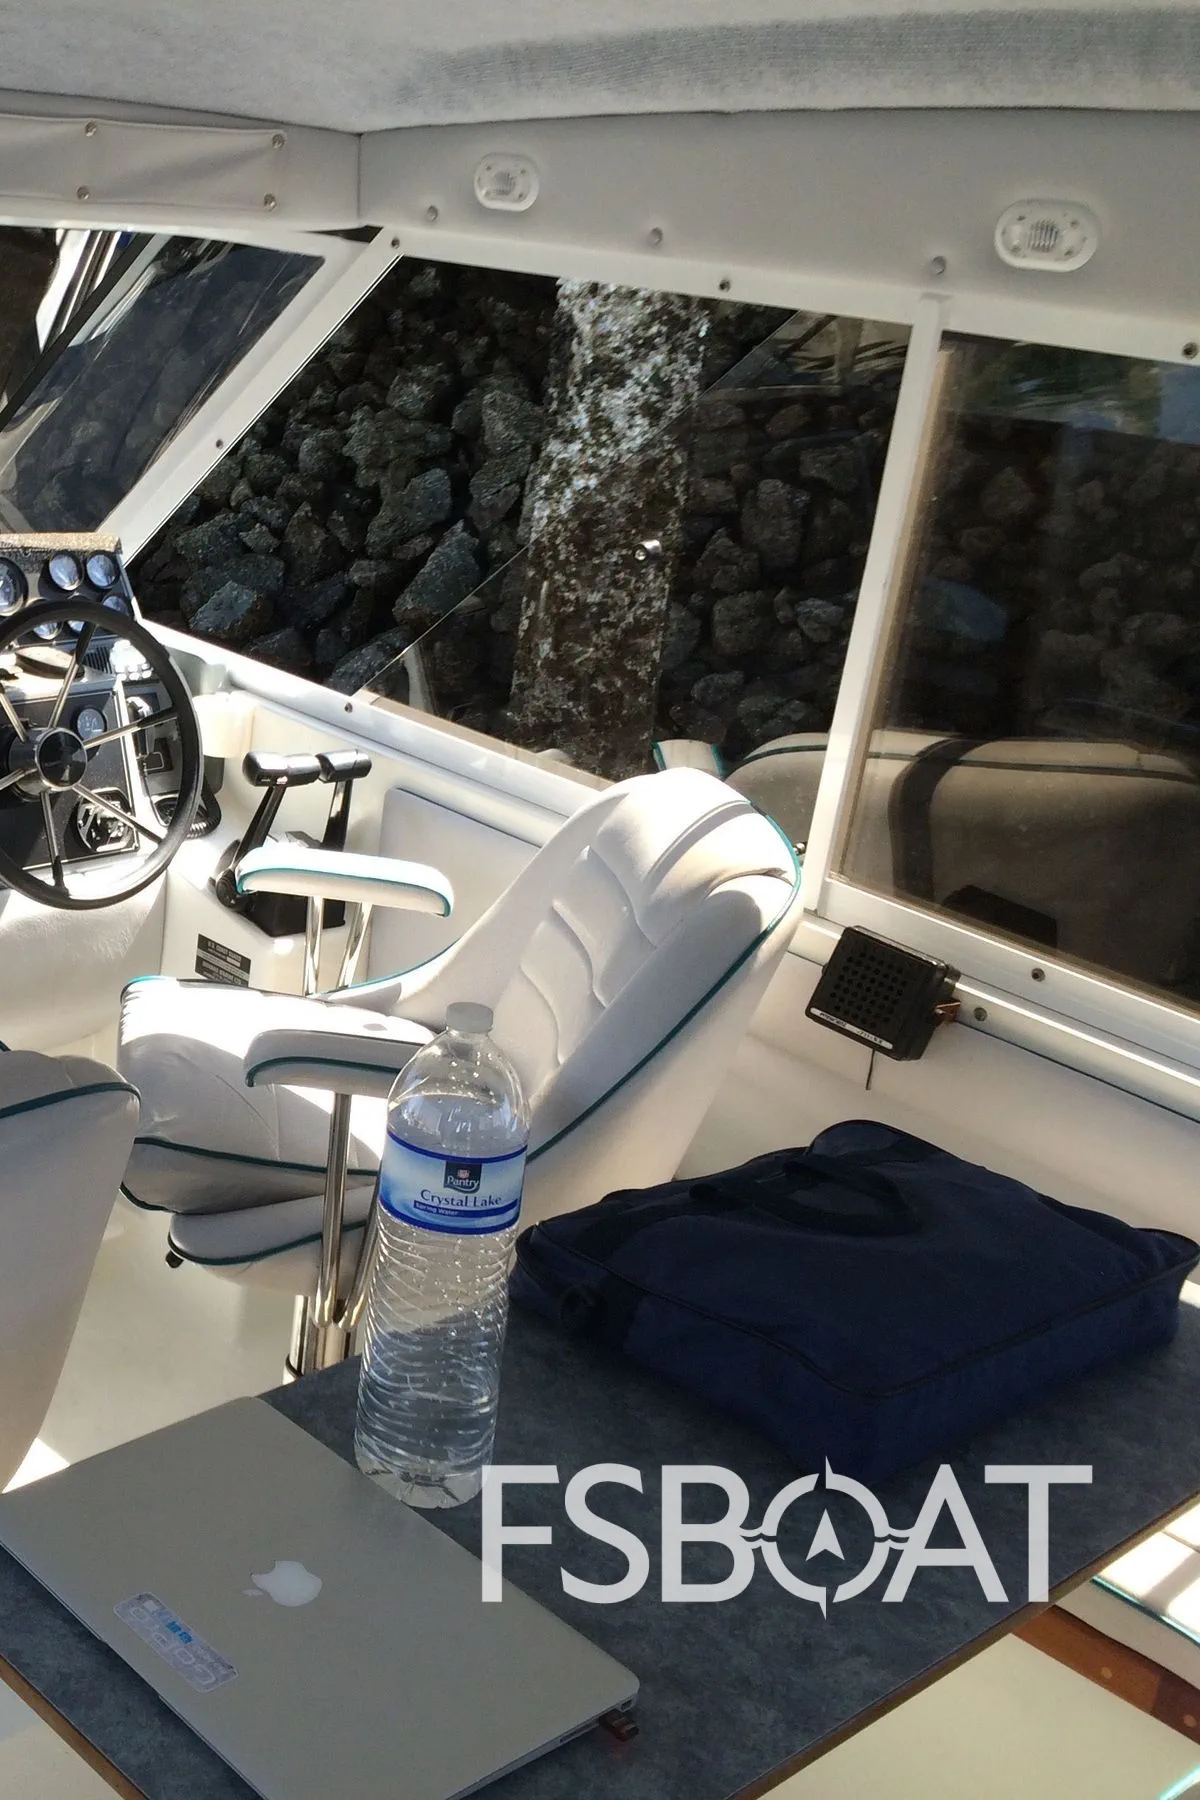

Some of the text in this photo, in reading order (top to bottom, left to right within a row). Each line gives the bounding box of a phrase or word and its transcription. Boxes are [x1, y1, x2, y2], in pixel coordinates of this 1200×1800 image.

[446, 1175, 480, 1190] Pantry
[420, 1189, 502, 1208] Crystal Lake
